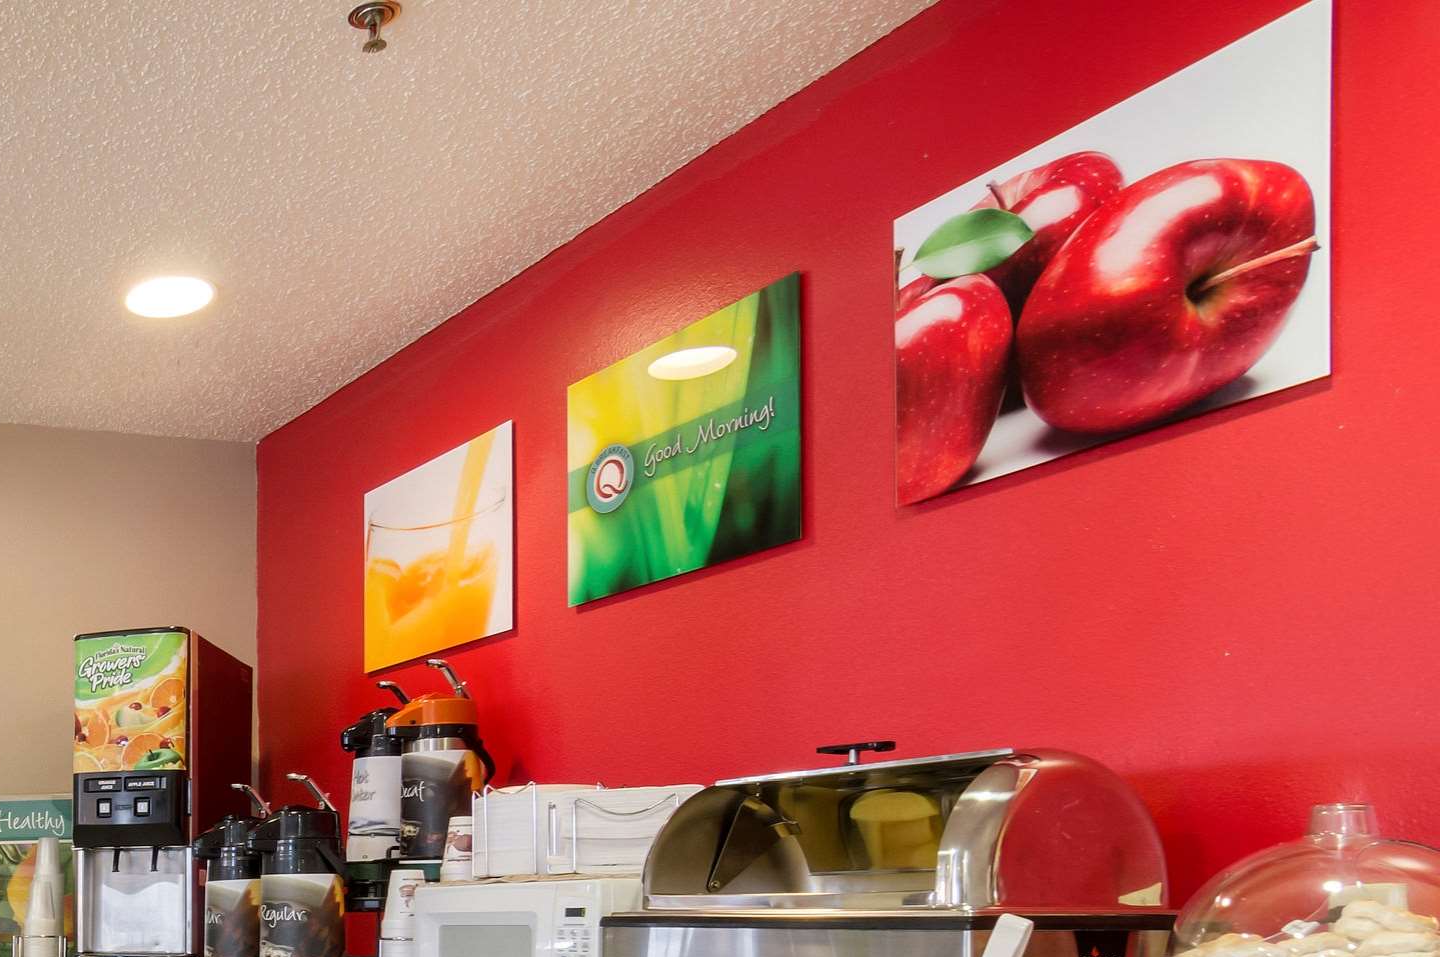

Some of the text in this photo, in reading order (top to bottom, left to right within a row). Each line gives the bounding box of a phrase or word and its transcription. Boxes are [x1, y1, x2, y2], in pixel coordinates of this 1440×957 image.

[643, 396, 776, 477] Good Morning!
[595, 459, 629, 499] Q
[90, 669, 133, 693] Pride
[260, 904, 306, 928] Regular
